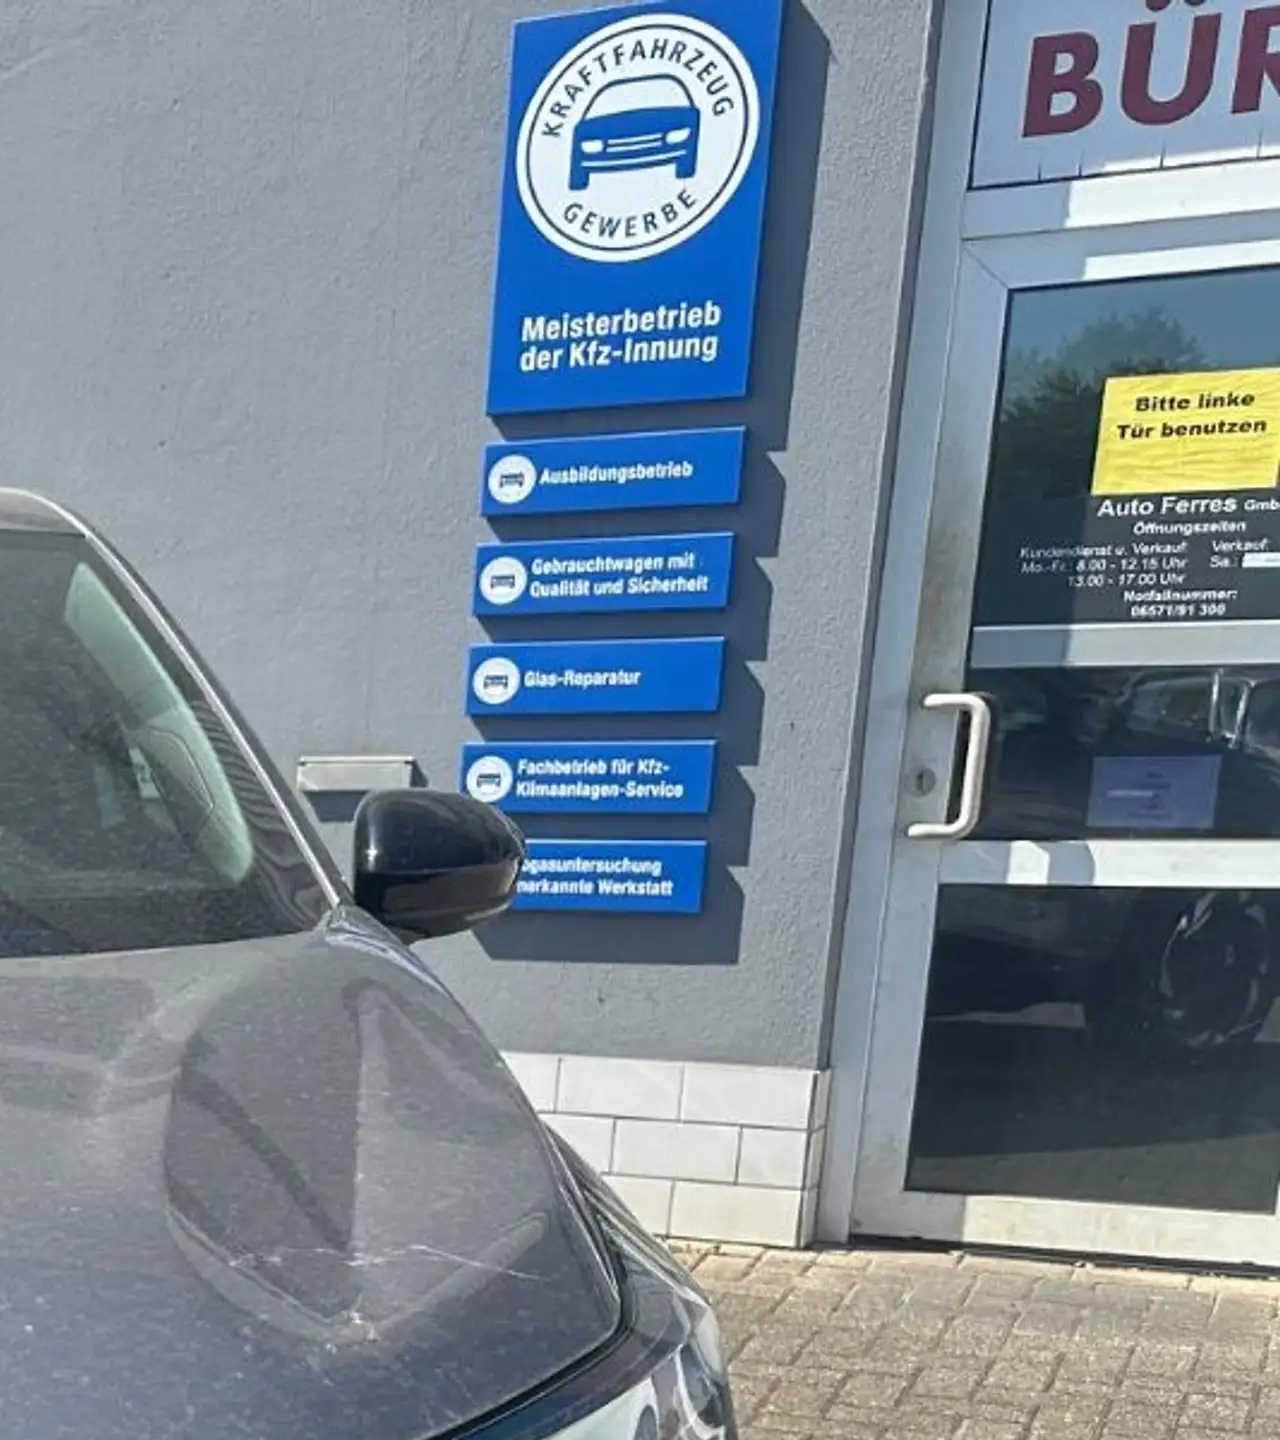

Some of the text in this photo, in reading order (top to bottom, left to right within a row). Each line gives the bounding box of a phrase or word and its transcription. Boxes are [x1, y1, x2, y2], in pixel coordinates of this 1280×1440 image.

[542, 37, 734, 138] KRAFTFAHRZEUG
[563, 188, 697, 239] GEWERBE
[521, 300, 722, 342] Meisterbetrieb
[519, 334, 718, 372] der Kfz-Innung
[1135, 392, 1255, 412] Bitte linke
[1117, 420, 1268, 439] Tür benutzen
[539, 460, 694, 485] Ausbildungsbetrieb
[1097, 499, 1154, 518] Auto
[1160, 496, 1238, 517] Ferres
[530, 552, 696, 576] Gebrauchtwagen mit
[529, 575, 709, 598] Qualität und Sicherheit
[523, 668, 642, 691] Glas-Reparatur
[517, 757, 671, 776] Fachbetrieb für Kfz-
[515, 780, 684, 801] Klimaanlagen-Service
[516, 878, 674, 896] nerkannte Werkstatt
